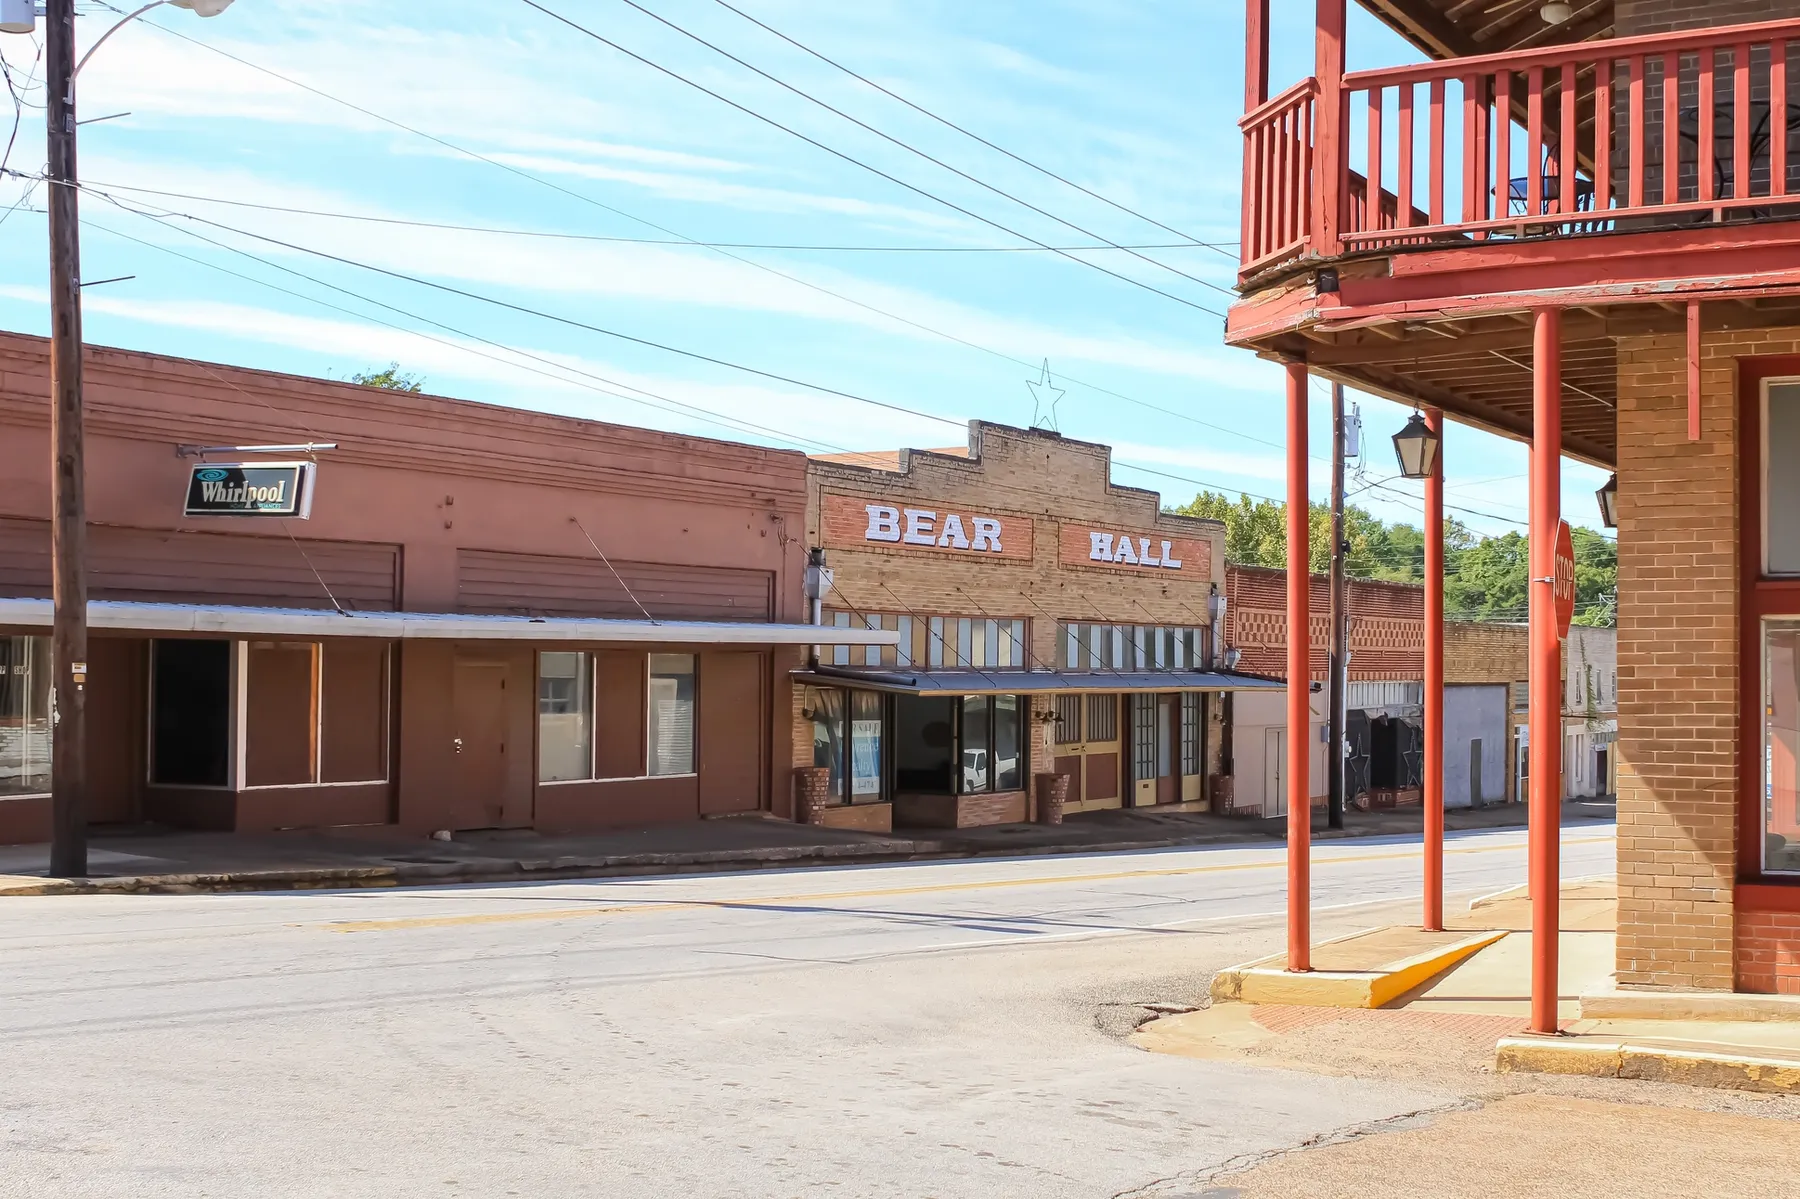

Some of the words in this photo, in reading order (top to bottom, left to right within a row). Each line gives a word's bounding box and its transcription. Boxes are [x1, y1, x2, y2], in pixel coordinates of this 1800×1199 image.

[201, 480, 286, 509] Whirlpool
[865, 504, 1003, 553] BEAR
[1089, 531, 1183, 569] HALL
[1555, 553, 1574, 601] STOP
